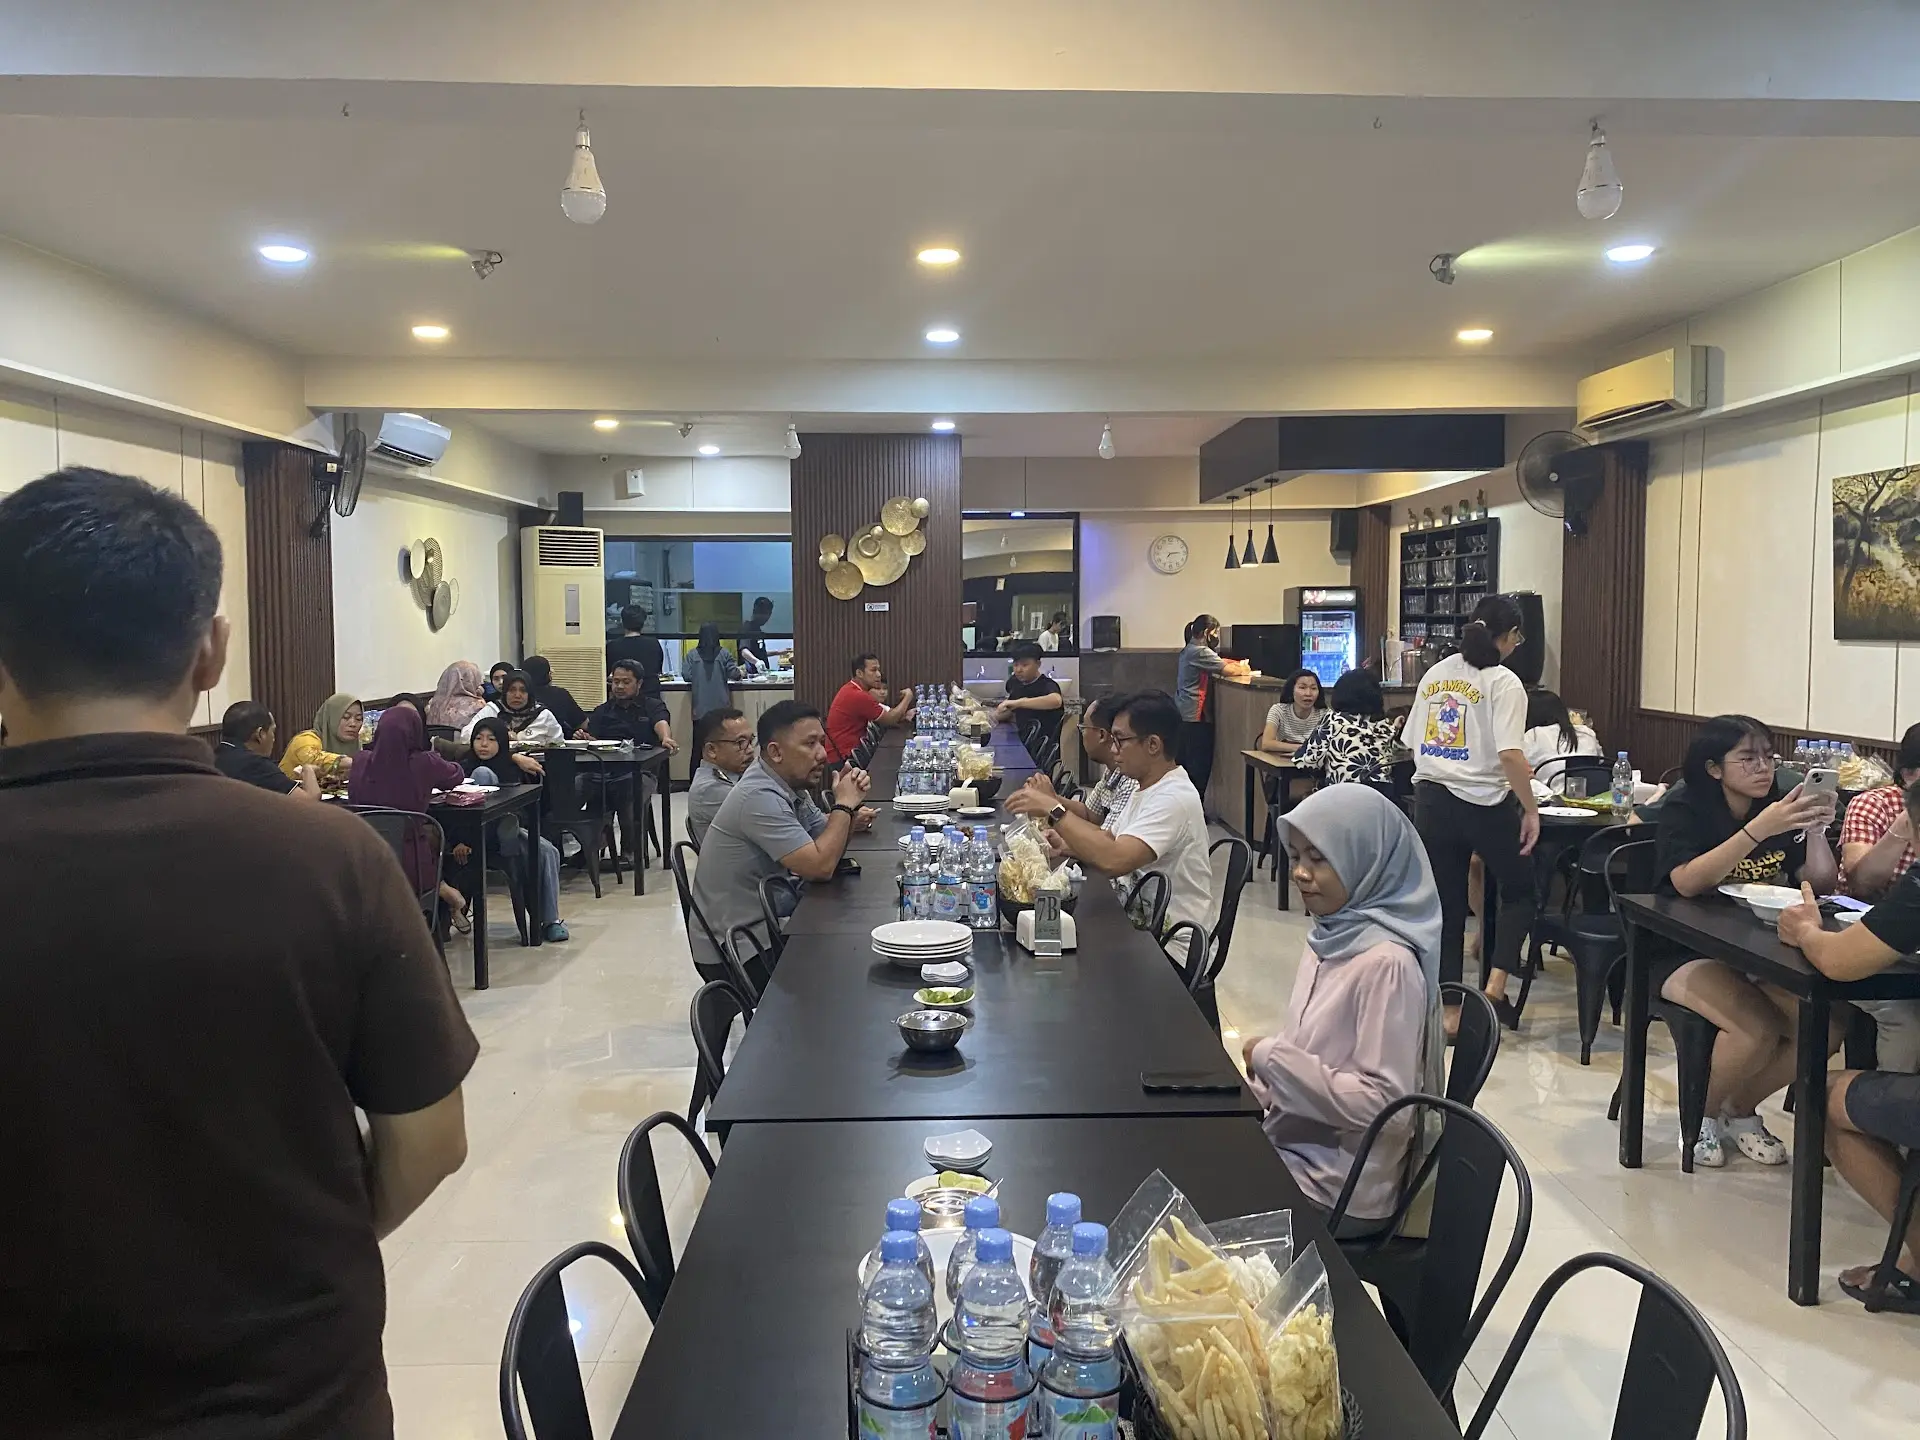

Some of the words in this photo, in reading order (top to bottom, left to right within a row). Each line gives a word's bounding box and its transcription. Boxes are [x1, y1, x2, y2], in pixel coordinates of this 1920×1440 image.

[1421, 680, 1440, 700] LOS
[1441, 680, 1484, 704] ANGELES
[1420, 744, 1469, 761] DODGERS
[1037, 896, 1058, 921] 7B
